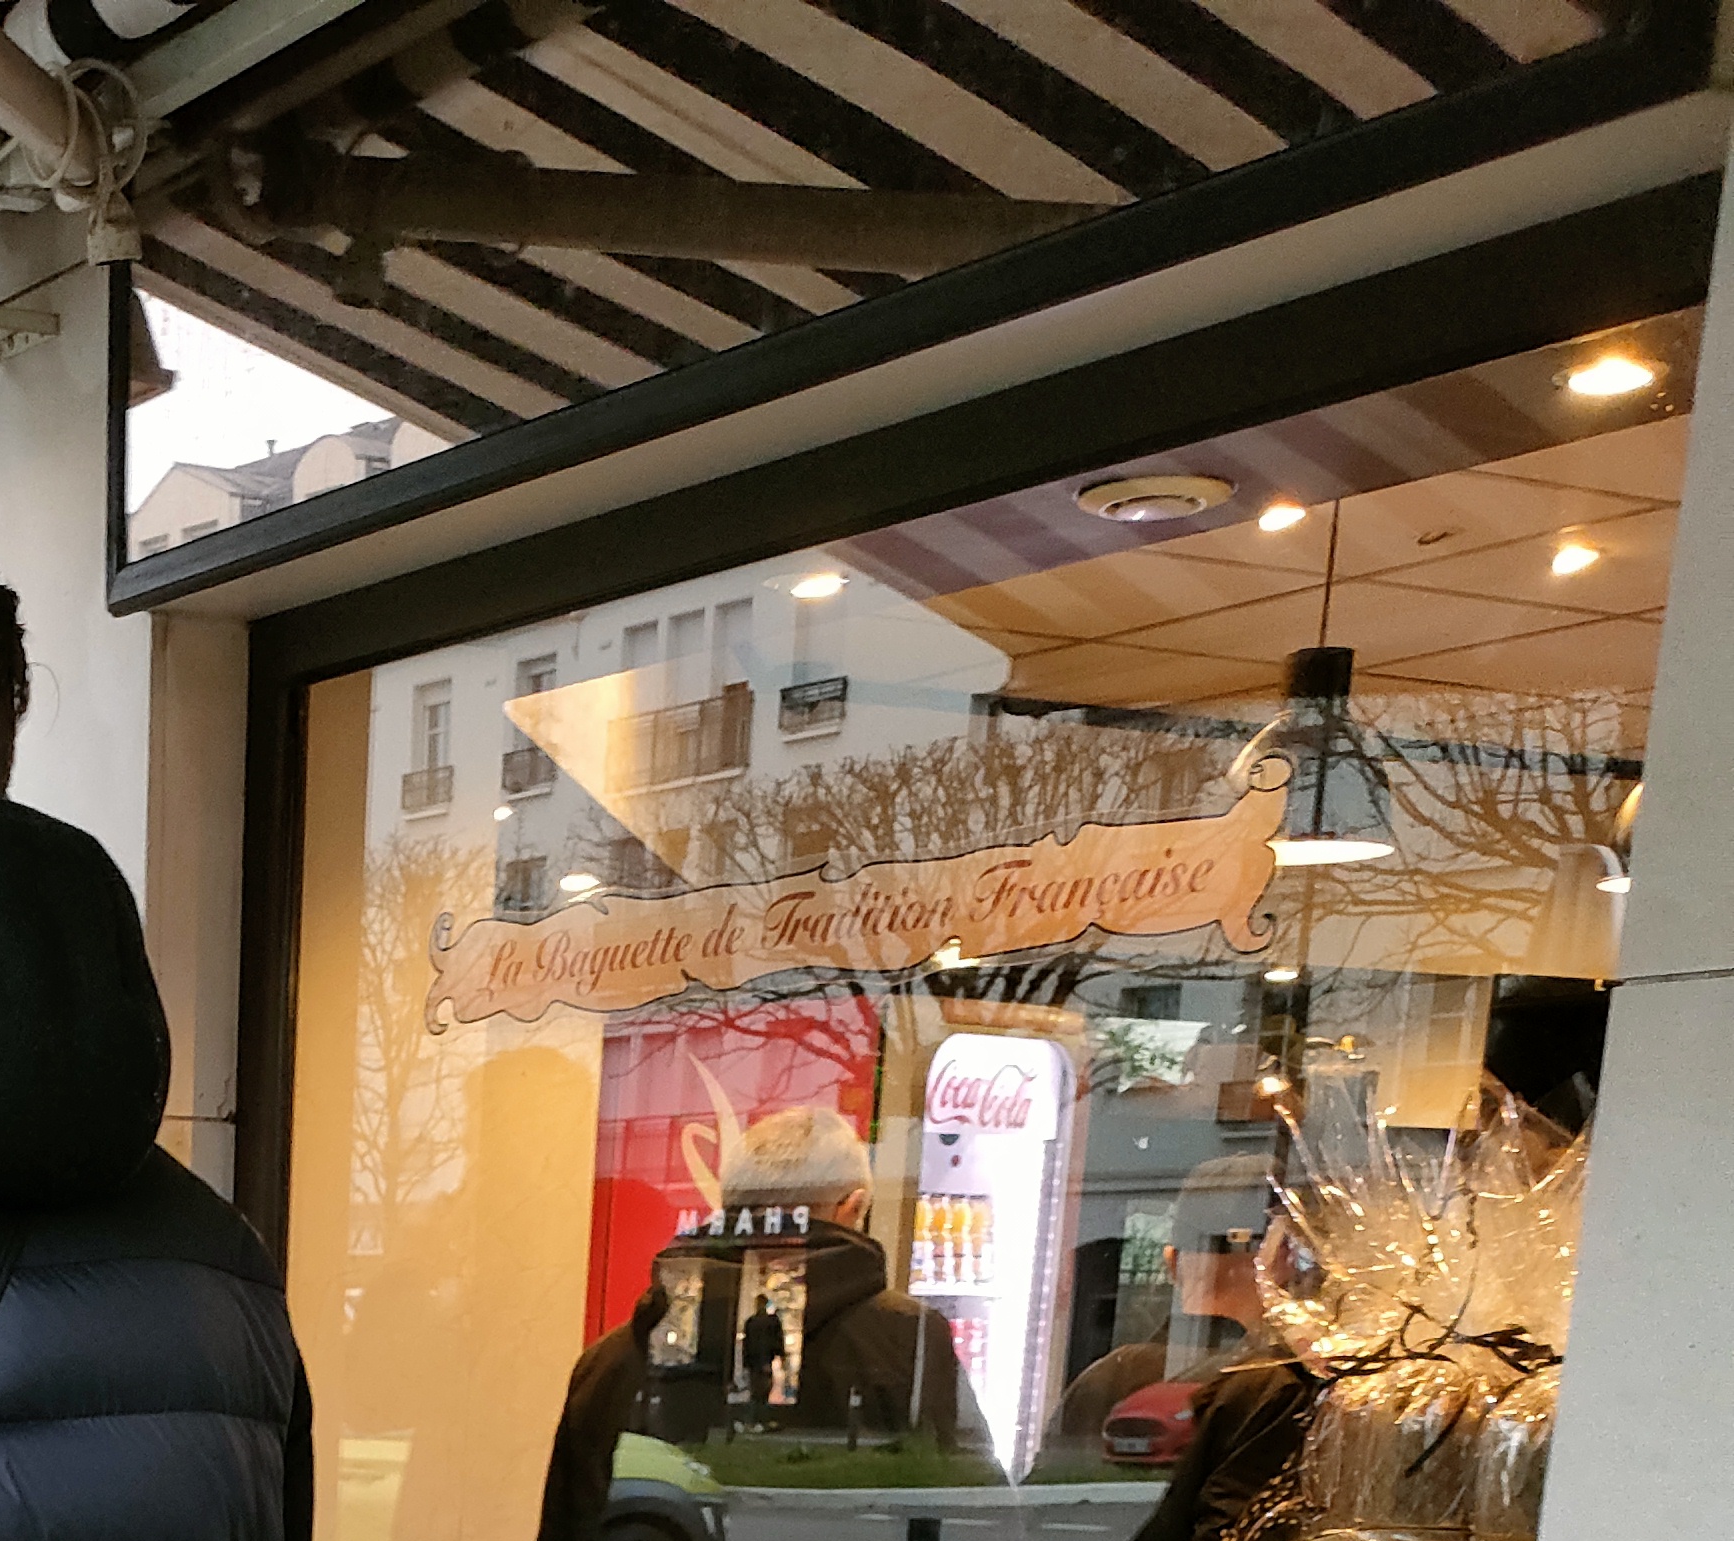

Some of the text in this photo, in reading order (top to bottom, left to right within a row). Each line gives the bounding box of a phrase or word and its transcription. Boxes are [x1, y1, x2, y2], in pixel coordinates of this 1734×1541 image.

[470, 847, 1216, 1000] La Baguette de Tradition Française
